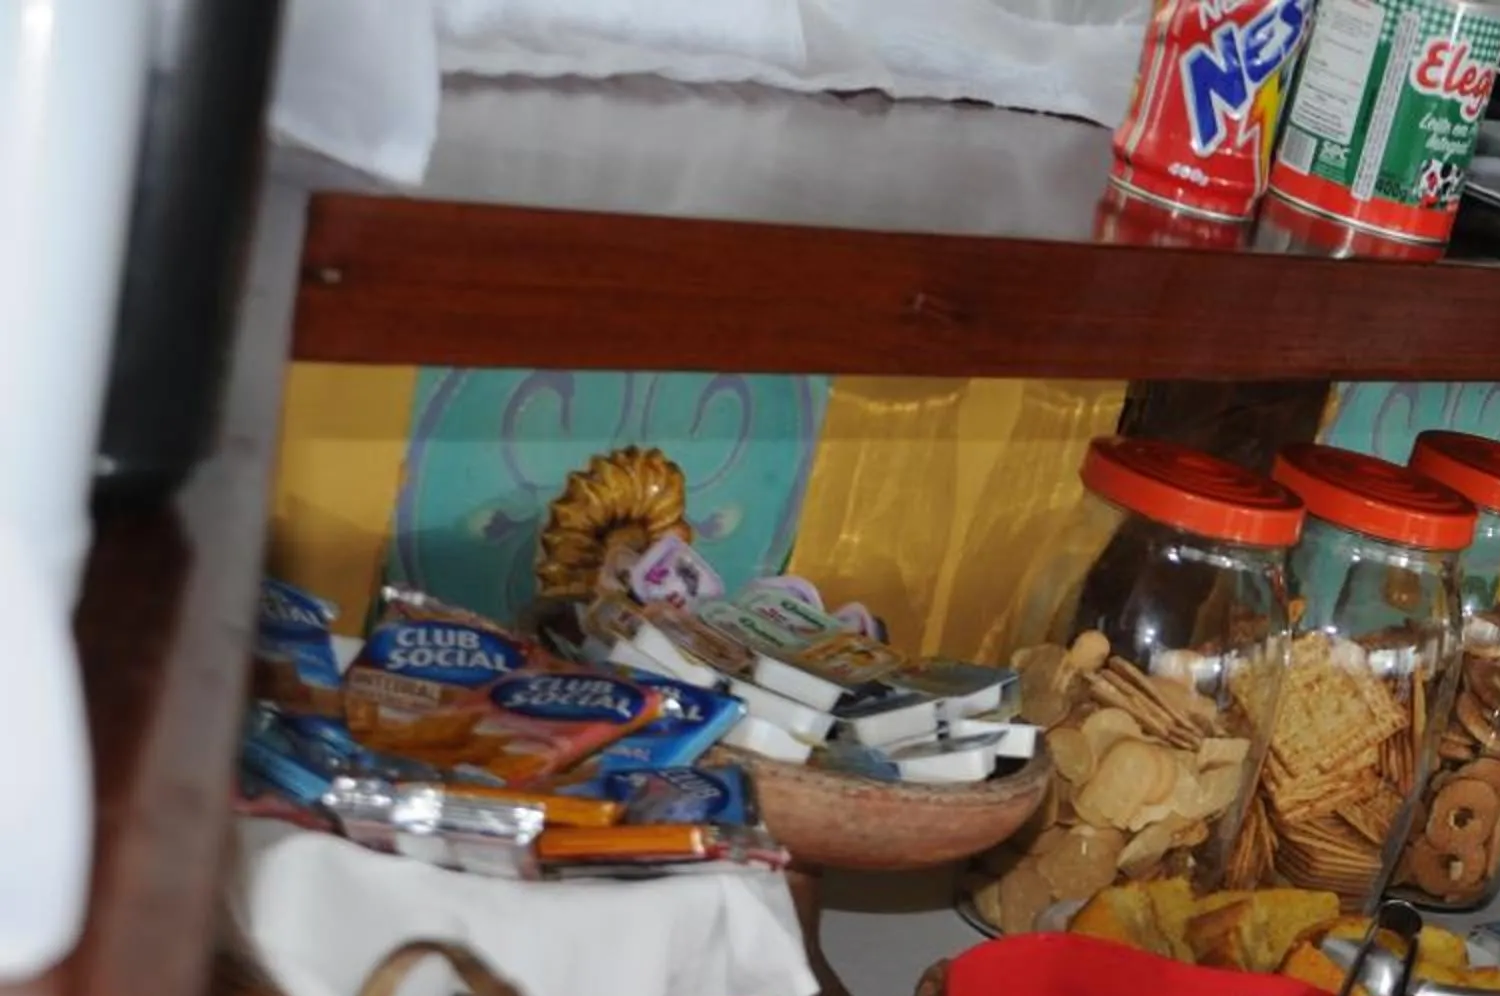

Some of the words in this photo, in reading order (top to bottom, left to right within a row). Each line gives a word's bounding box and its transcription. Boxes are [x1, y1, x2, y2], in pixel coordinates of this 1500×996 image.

[396, 626, 481, 650] CLUB
[385, 647, 514, 673] SOCIAL
[528, 676, 616, 694] CLUB
[504, 688, 632, 719] SOCIAL
